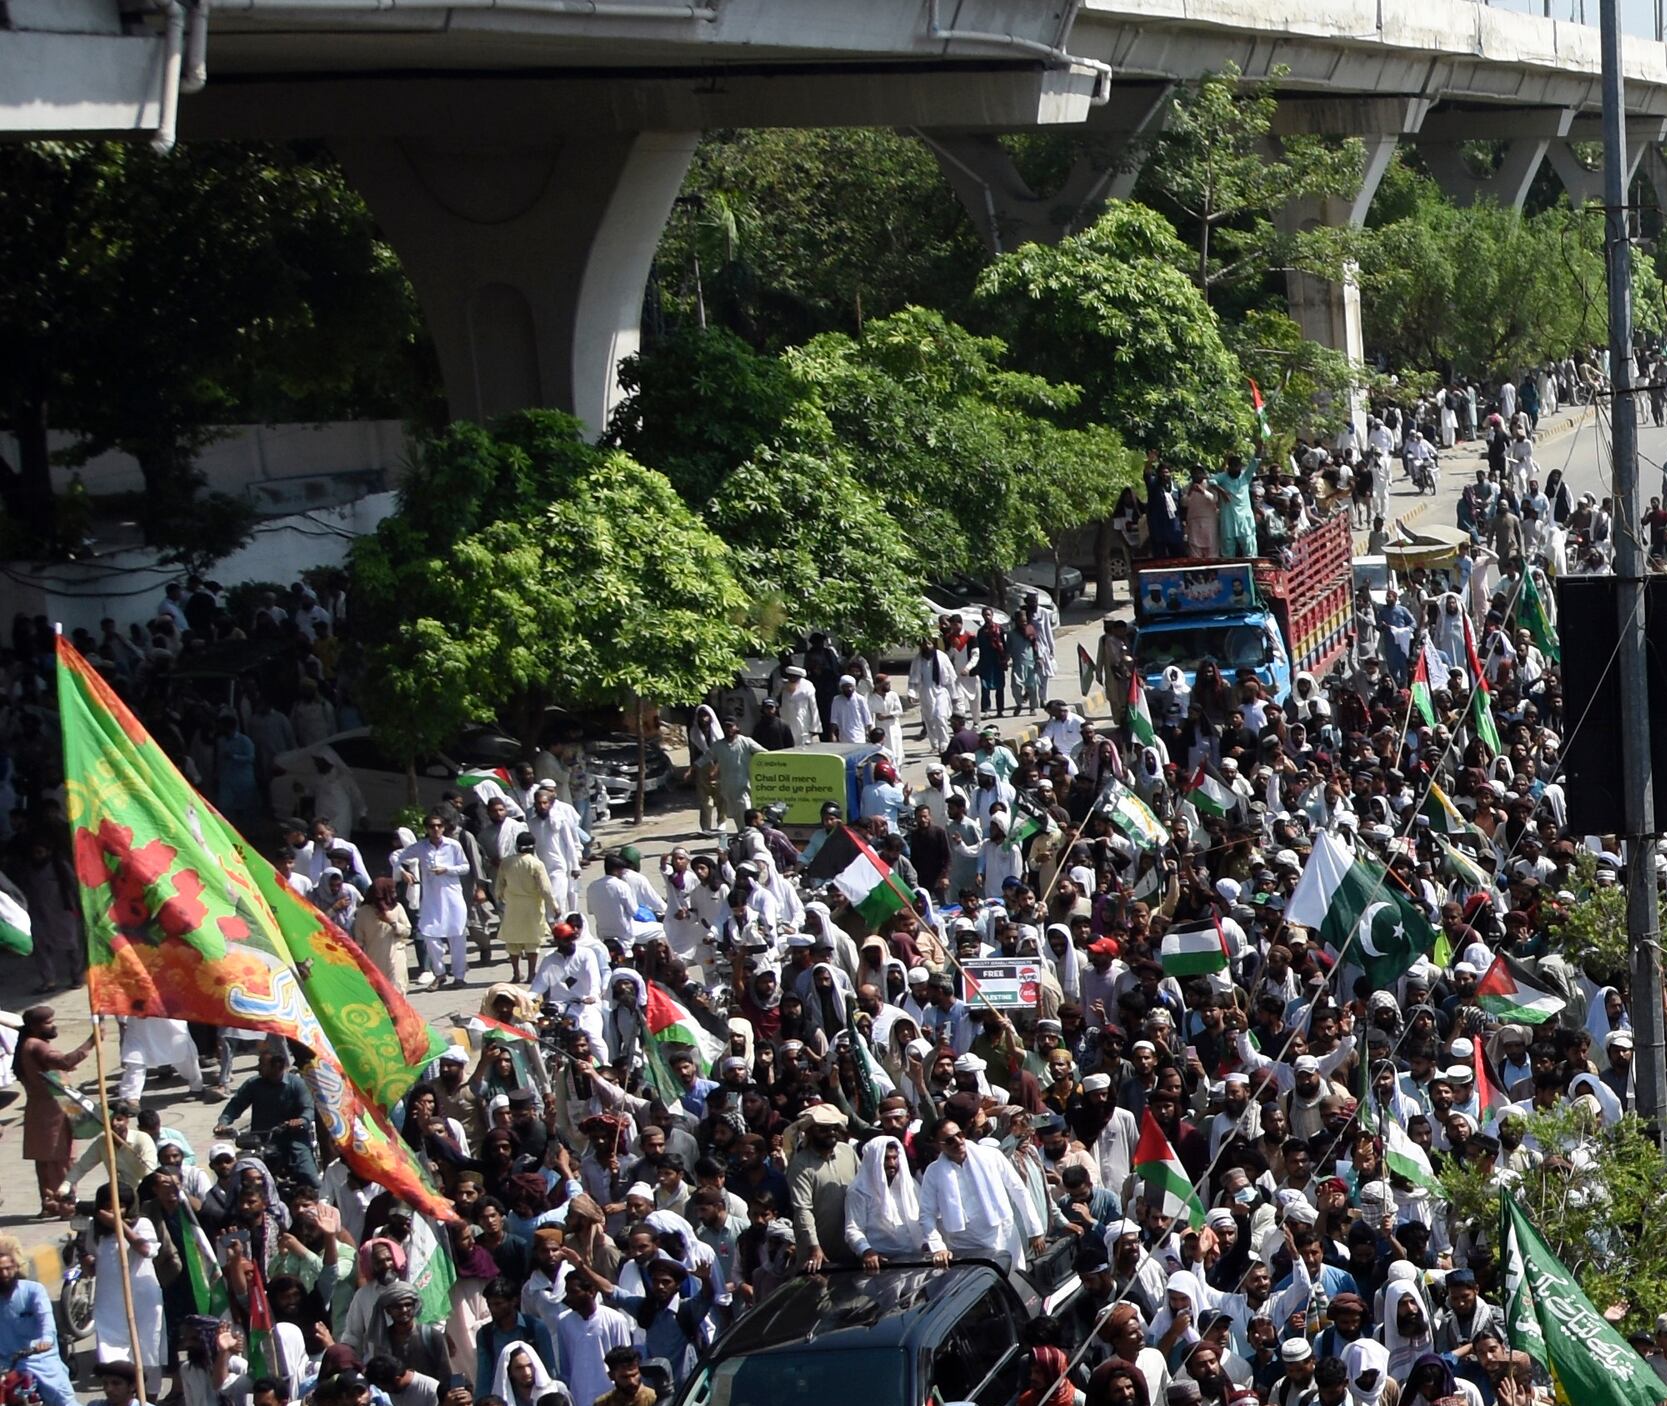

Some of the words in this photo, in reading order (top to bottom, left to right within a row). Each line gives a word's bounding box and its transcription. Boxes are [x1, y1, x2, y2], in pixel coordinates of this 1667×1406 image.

[755, 773, 776, 783] Chal
[778, 774, 790, 782] Dil
[779, 784, 790, 792] de
[793, 785, 804, 793] ye
[806, 784, 833, 793] phere
[983, 969, 1004, 977] FREE
